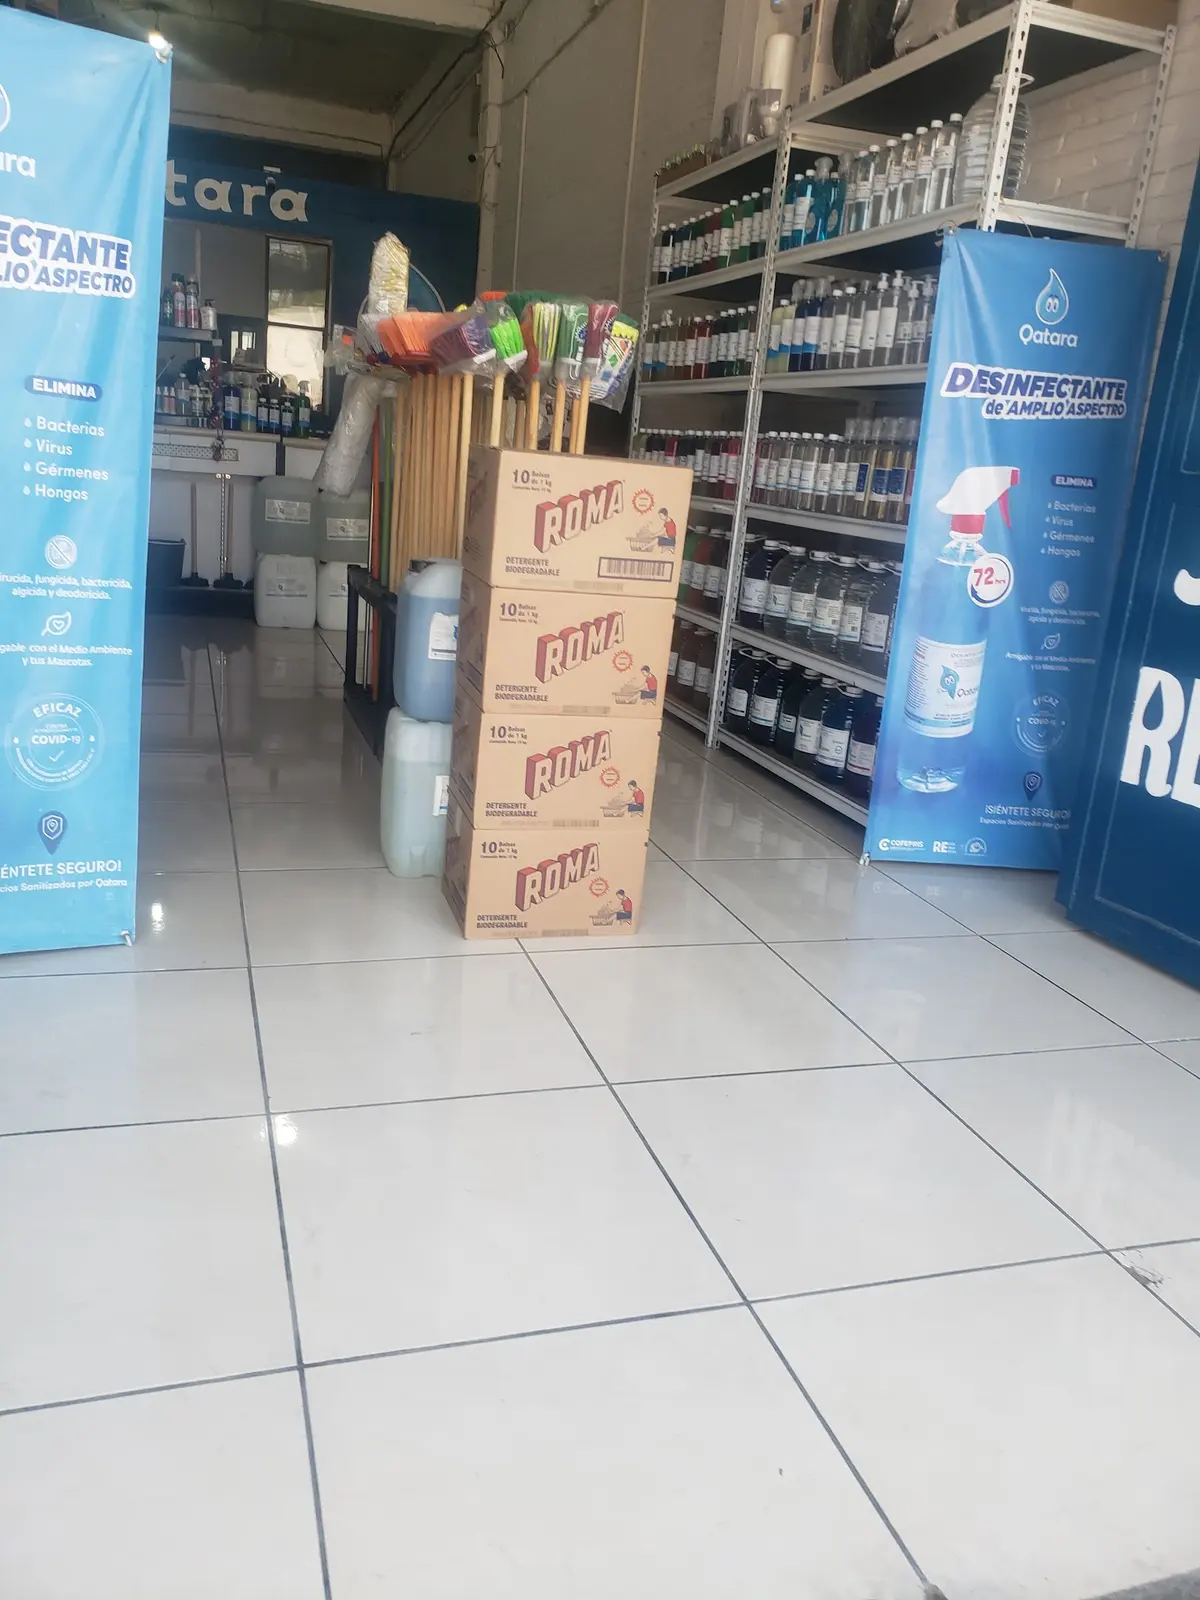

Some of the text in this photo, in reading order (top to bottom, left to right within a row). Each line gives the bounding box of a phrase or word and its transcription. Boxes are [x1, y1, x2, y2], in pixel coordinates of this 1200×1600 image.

[0, 261, 133, 293] IO ASPECTRO
[1019, 324, 1078, 347] Qatara
[32, 378, 97, 398] ELIMINA
[945, 367, 1125, 400] DESINFECTANTE
[985, 399, 1125, 416] de AMPLIO ASPECTRO
[36, 415, 105, 437] Bacterias
[36, 438, 73, 455] Virus
[35, 459, 109, 481] Gérmenes
[513, 469, 530, 484] 10
[1055, 475, 1094, 488] ELIMINA
[35, 483, 89, 502] Hongos
[1053, 501, 1097, 513] Bacterias
[533, 479, 624, 553] ROMA
[1052, 514, 1074, 527] Virus
[1050, 530, 1095, 543] Gérmenes
[1047, 545, 1081, 558] Hongos
[505, 556, 549, 567] DETERGENTE
[505, 565, 560, 576] BIODEGRADABLE
[973, 567, 995, 587] 72
[500, 602, 517, 616] 10
[535, 611, 625, 683] ROMA
[495, 684, 538, 694] DETERGENTE
[495, 692, 548, 702] BIODEGRADABLE
[32, 702, 82, 719] EFICAZ
[490, 725, 507, 738] 10
[31, 734, 81, 745] COVID-19
[525, 730, 612, 800] ROMA
[485, 810, 538, 818] BIODEGRADABLE
[481, 841, 498, 854] 10
[890, 840, 924, 848] COFEPRIS
[933, 841, 949, 854] RE
[0, 860, 122, 879] ÉNTETE SEGURO!
[515, 843, 600, 912] ROMA
[20, 880, 76, 892] Sanitizados
[77, 880, 93, 890] por
[95, 878, 128, 888] Qatara
[476, 921, 529, 929] BIODEGRADABLE
[477, 914, 518, 922] DETERGENTE
